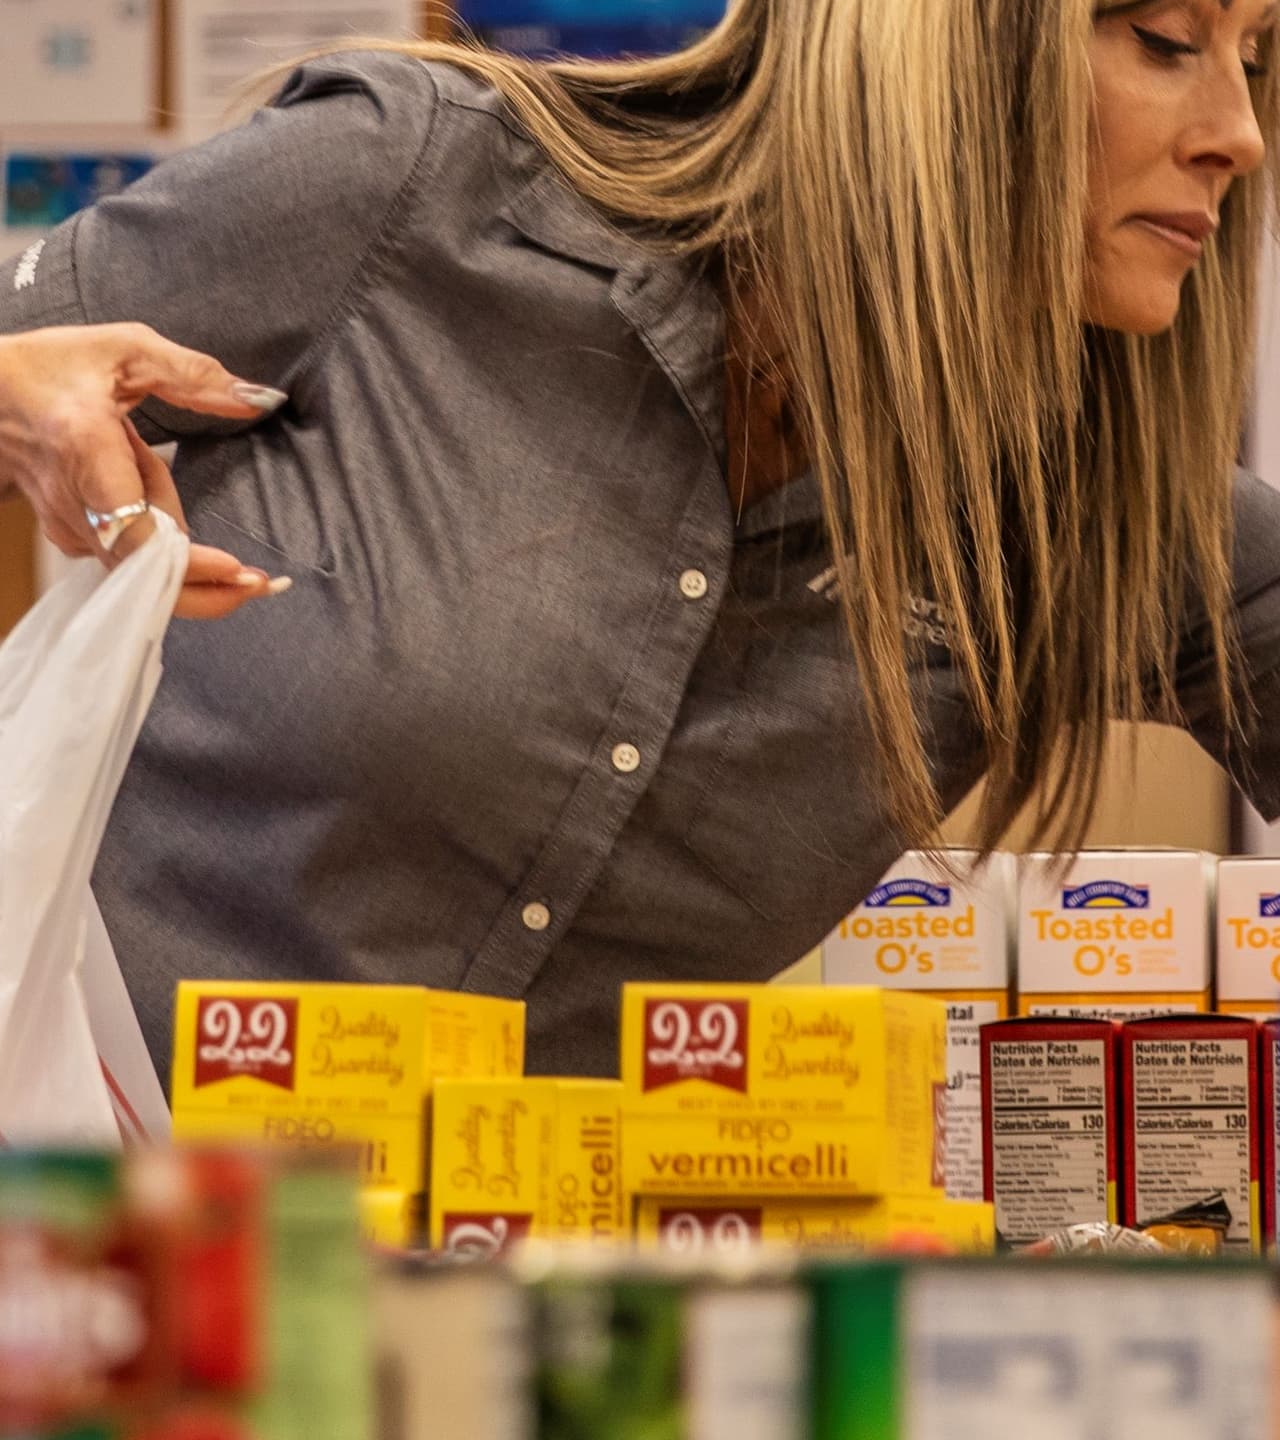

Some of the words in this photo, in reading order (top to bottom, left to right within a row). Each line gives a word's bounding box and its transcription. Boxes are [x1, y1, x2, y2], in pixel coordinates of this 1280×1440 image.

[1030, 907, 1174, 941] Toasted
[875, 943, 933, 975] O's
[1073, 944, 1133, 977] O's
[319, 1005, 400, 1048] Quality
[770, 1006, 854, 1049] Quality
[992, 1044, 1043, 1055] Nutrition
[1047, 1042, 1078, 1054] Facts
[993, 1056, 1026, 1067] Datos
[1029, 1056, 1043, 1066] de
[1047, 1054, 1100, 1066] Nutrición
[1136, 1043, 1186, 1053] Nutrition
[1190, 1042, 1221, 1052] Facts
[1136, 1055, 1168, 1066] Datos
[1172, 1055, 1186, 1065] de
[1190, 1053, 1243, 1065] Nutrición
[310, 1042, 404, 1087] Quantity
[763, 1043, 860, 1088] Quantity
[264, 1116, 334, 1142] FIDEO
[718, 1118, 792, 1143] FIDEO
[1082, 1114, 1104, 1129] 130
[1225, 1113, 1246, 1129] 130
[649, 1142, 849, 1178] vermicelli
